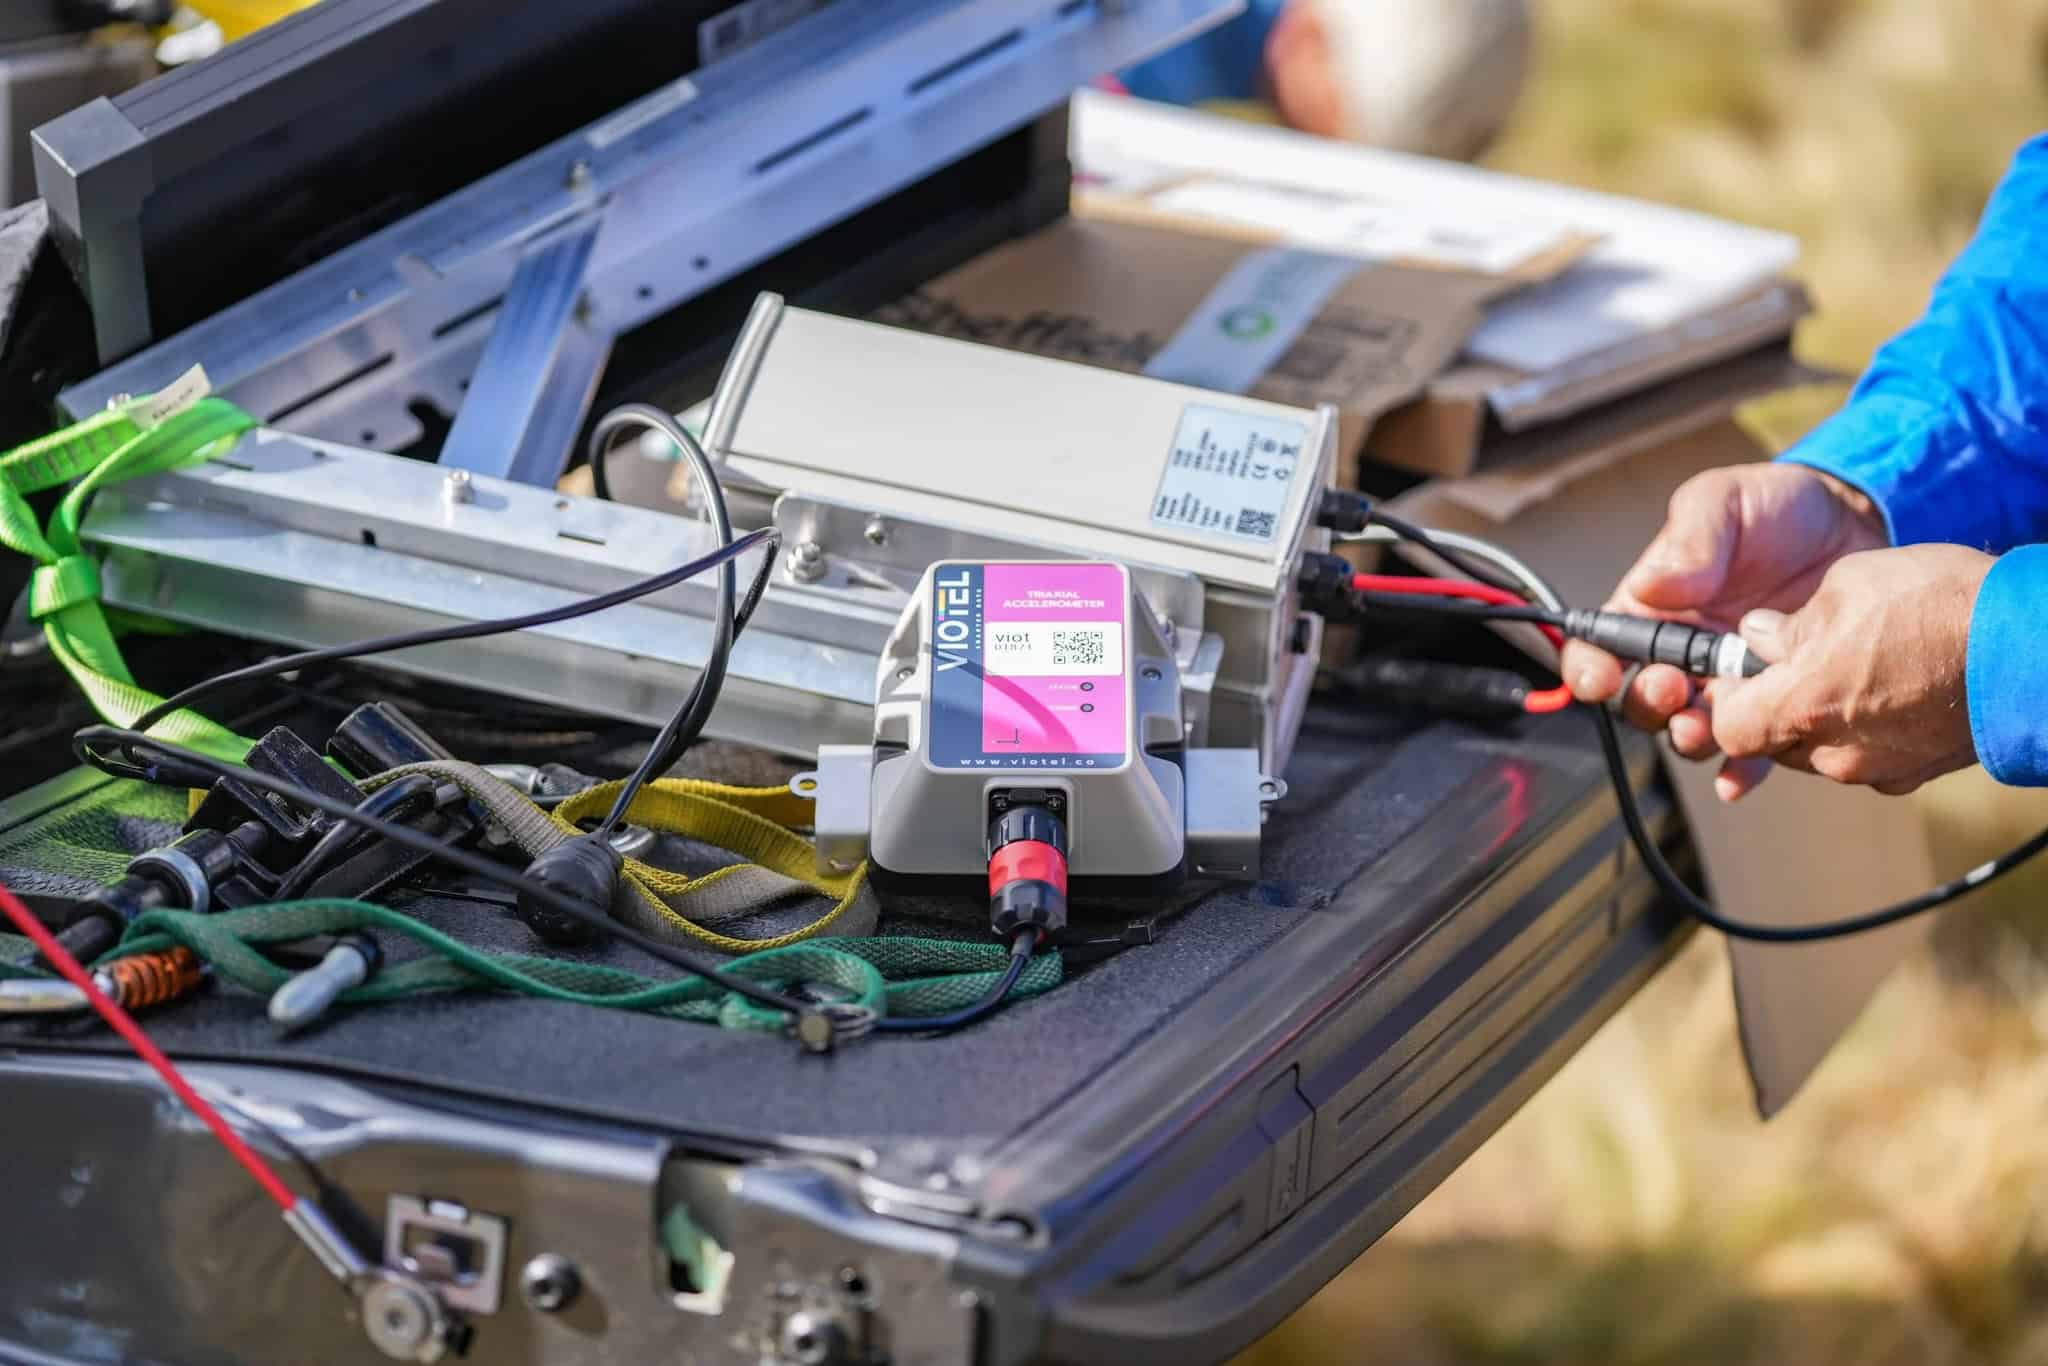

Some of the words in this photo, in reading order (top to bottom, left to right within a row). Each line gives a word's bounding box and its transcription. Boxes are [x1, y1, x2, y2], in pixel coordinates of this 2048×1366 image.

[1027, 590, 1080, 599] TRIAXIAL
[1002, 599, 1105, 609] ACCELEROMETER
[937, 571, 970, 672] VIOTEL
[995, 632, 1030, 642] viot
[960, 757, 1096, 766] www.viotel.co
